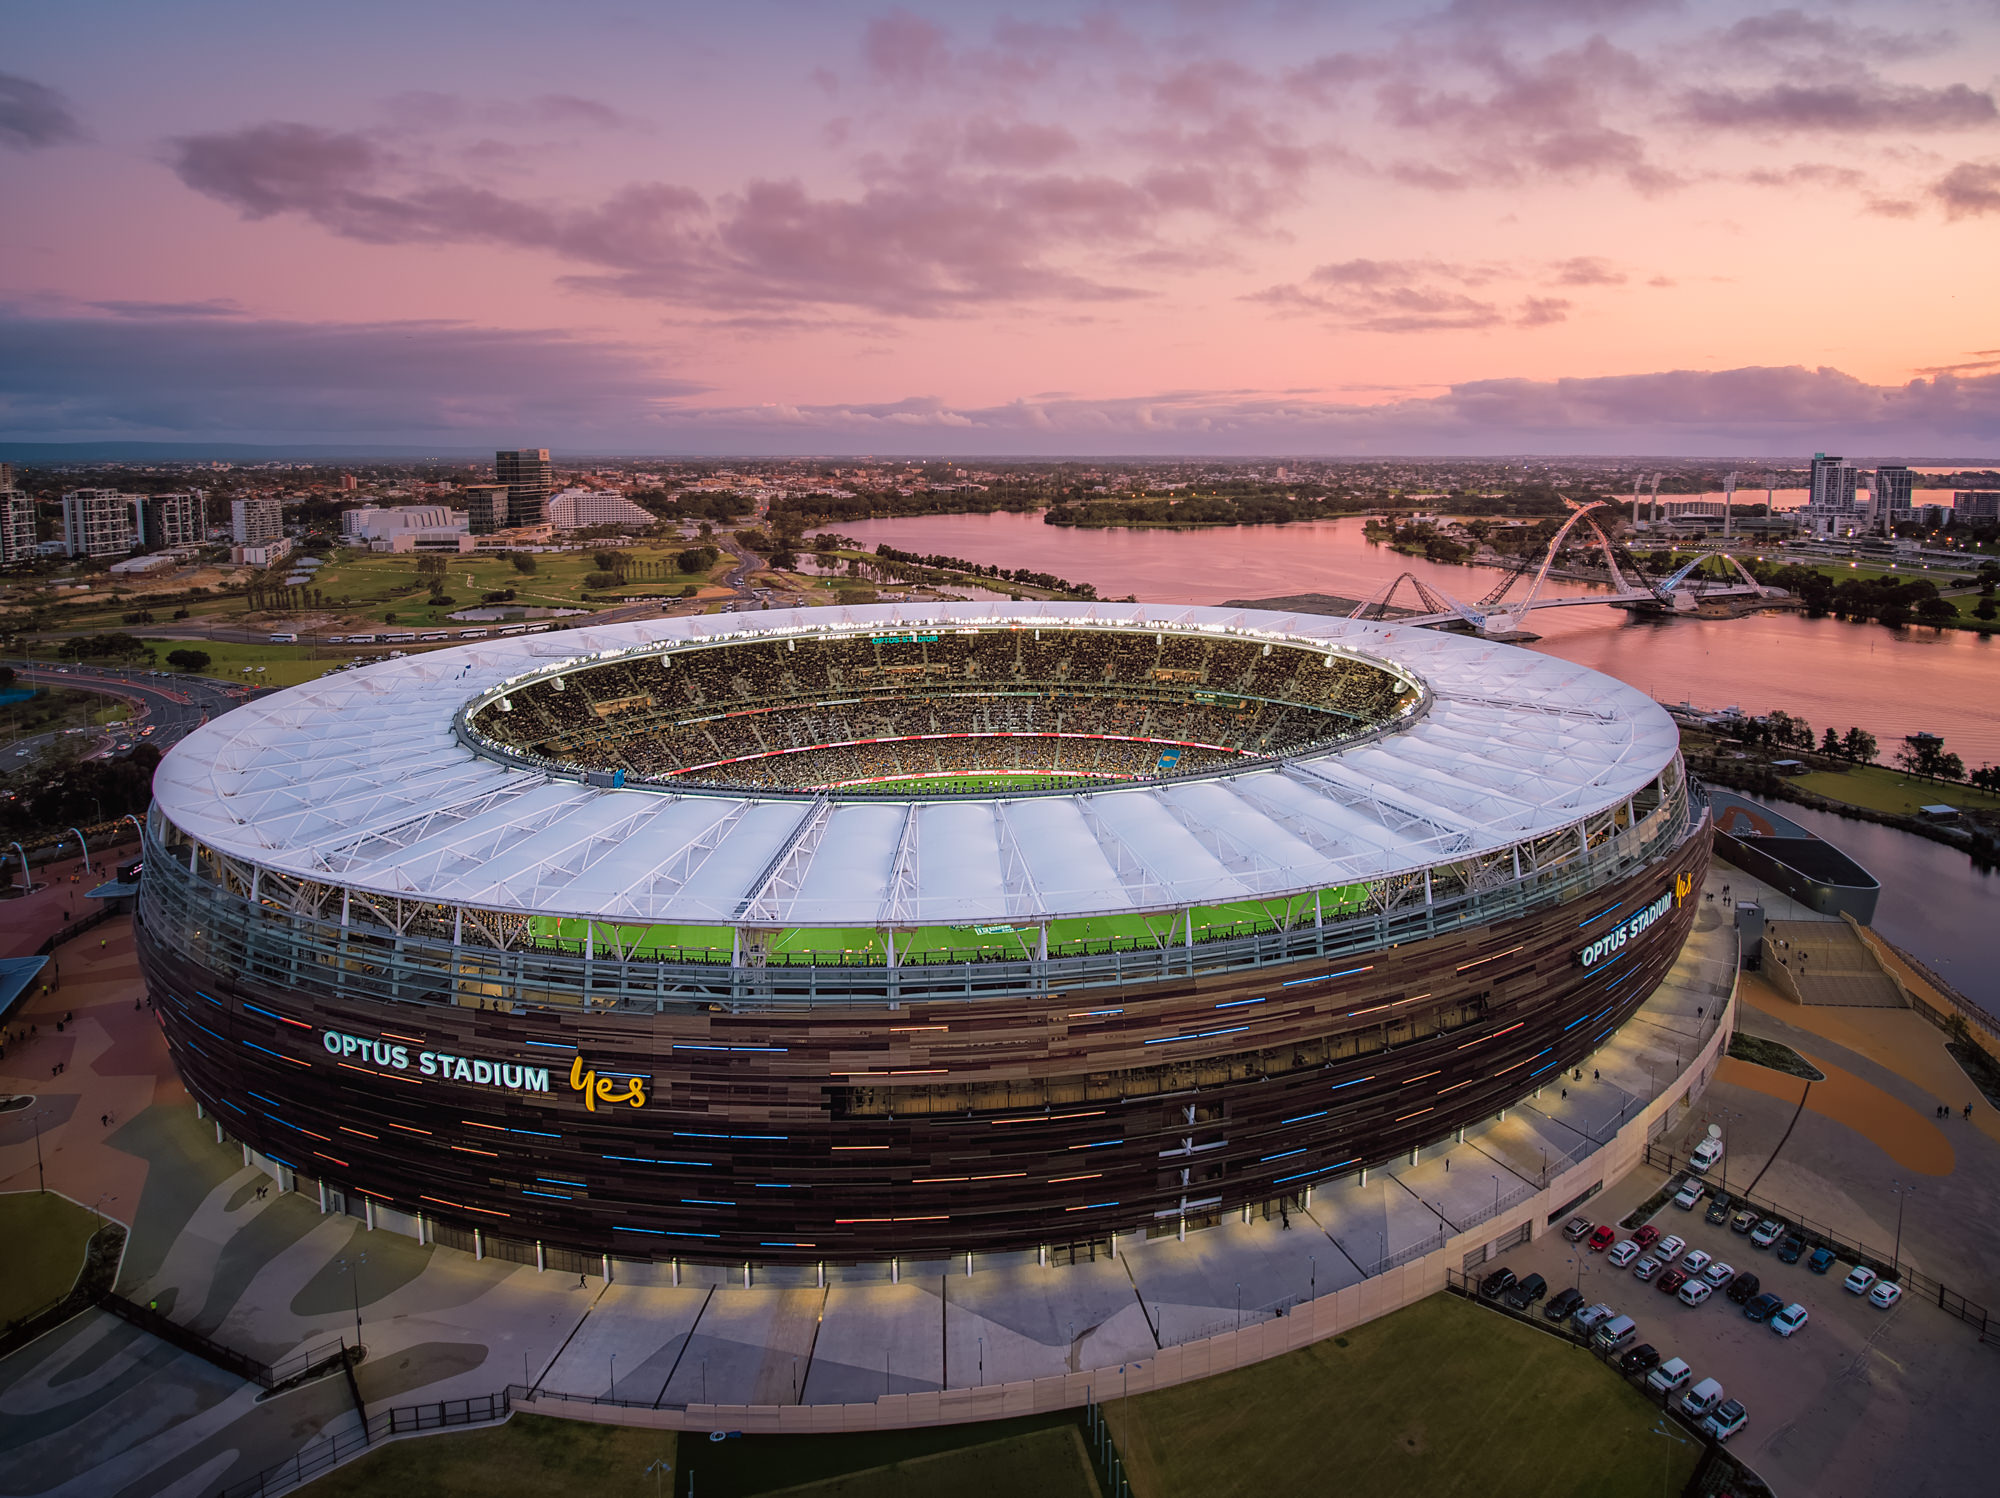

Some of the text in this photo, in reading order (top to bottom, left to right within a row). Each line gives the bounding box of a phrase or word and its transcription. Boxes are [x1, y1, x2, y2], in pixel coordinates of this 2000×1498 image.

[872, 635, 939, 645] OPTUS STDIUM
[1675, 872, 1692, 909] yes
[1582, 892, 1672, 967] OPTUS STADIUM
[323, 1030, 549, 1092] OPTUS STADIUM
[570, 1055, 646, 1112] yes
